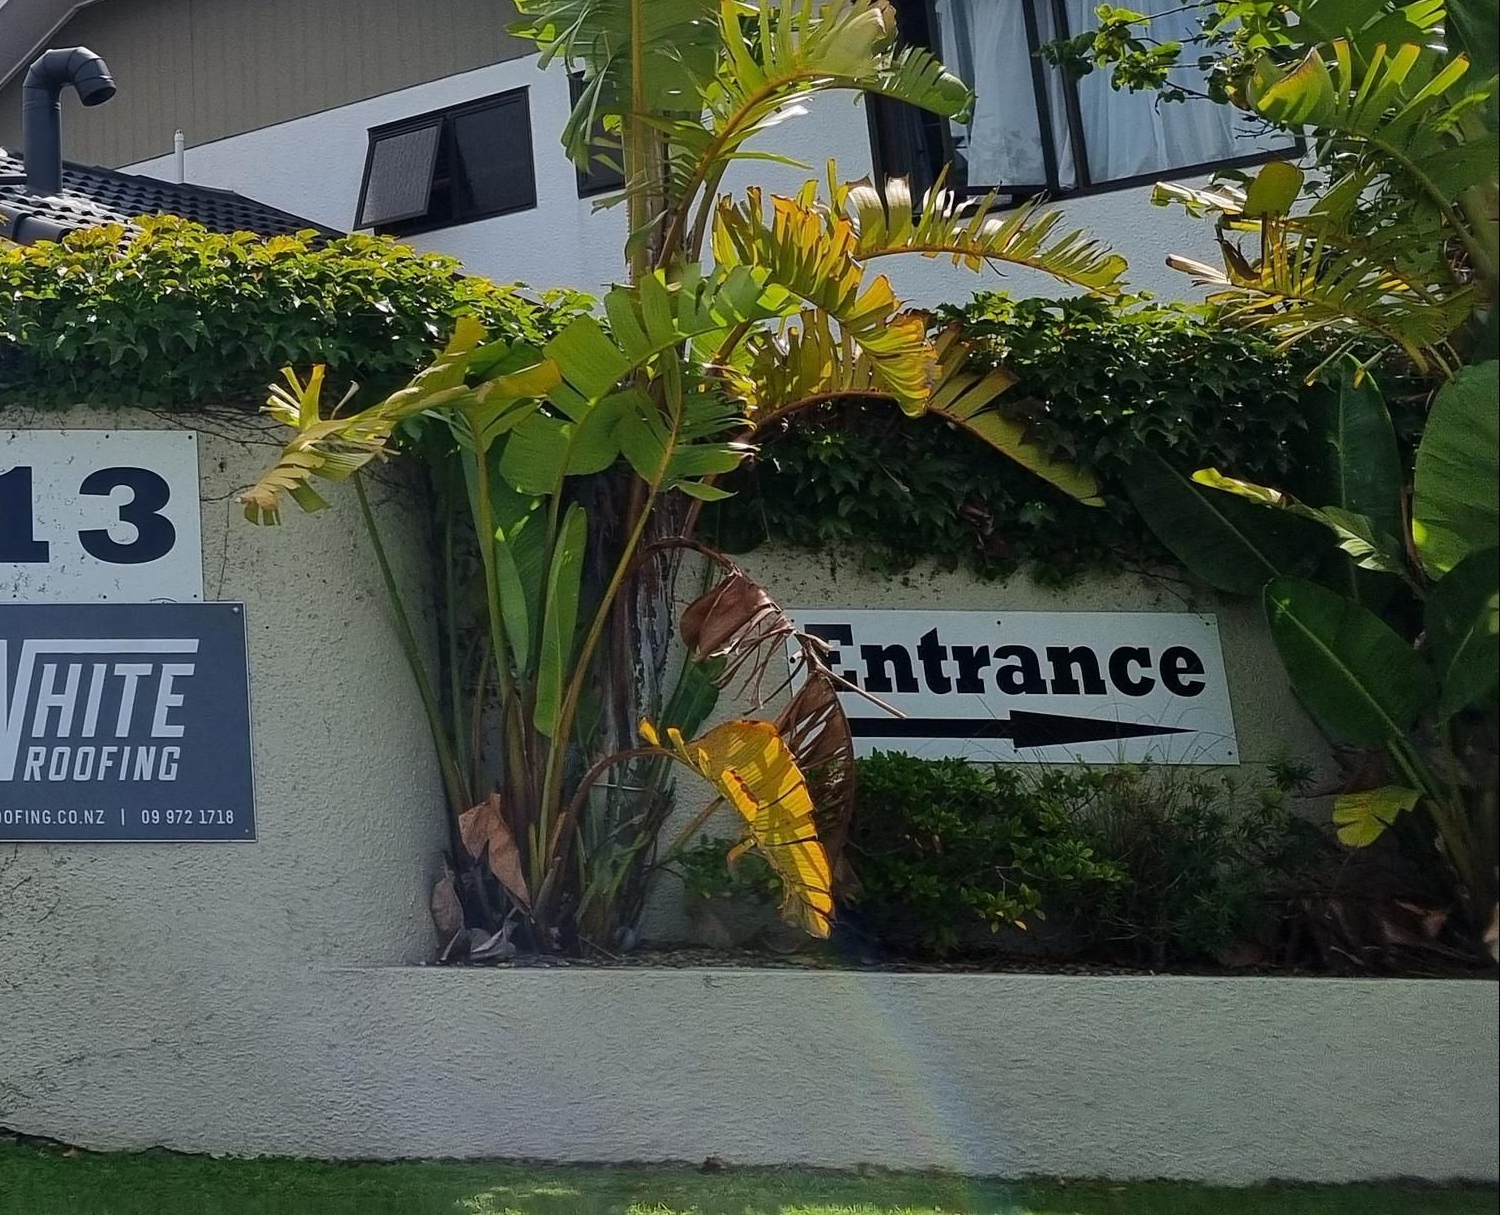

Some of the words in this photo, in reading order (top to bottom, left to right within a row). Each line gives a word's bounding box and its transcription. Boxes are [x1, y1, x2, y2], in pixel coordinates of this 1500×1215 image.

[804, 624, 1206, 697] Entrance
[23, 746, 181, 782] ROOFING
[141, 809, 160, 825] 09
[165, 809, 194, 825] 972
[198, 809, 235, 825] 1718
